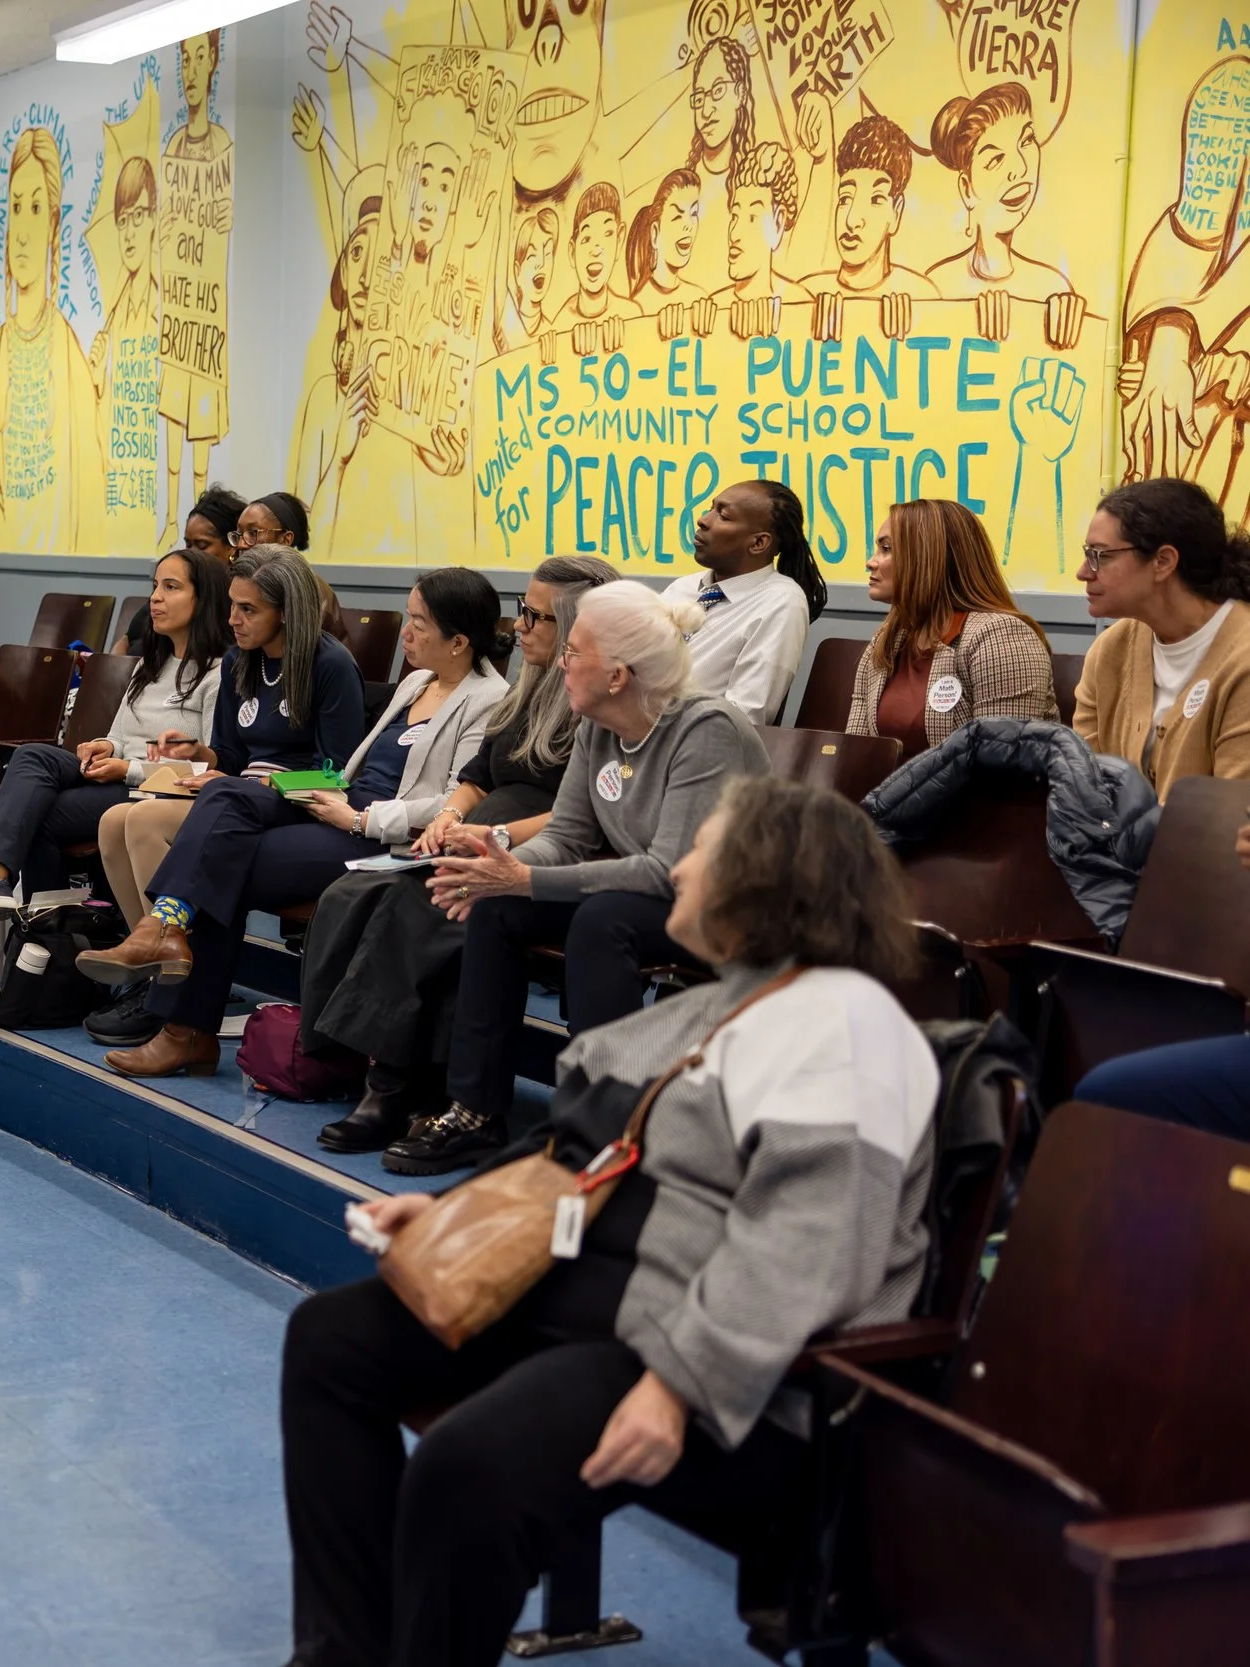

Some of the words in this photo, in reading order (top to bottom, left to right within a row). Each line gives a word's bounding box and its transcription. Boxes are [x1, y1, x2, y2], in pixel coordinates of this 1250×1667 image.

[789, 0, 856, 78] LOVE
[994, 0, 1069, 32] ADRE
[441, 48, 481, 69] MY
[805, 17, 857, 76] YOUR
[969, 6, 1058, 103] TIERRA
[104, 99, 129, 124] THE
[1195, 86, 1229, 110] SEE
[82, 150, 104, 223] WONG
[165, 161, 189, 193] CAN
[193, 167, 200, 200] A
[205, 151, 231, 199] MAN
[1184, 183, 1220, 201] NOT
[29, 102, 74, 189] CLIMATE
[57, 203, 78, 321] ACTIVIST
[168, 192, 195, 224] LOVE
[197, 198, 218, 230] GOD
[176, 228, 205, 267] and
[78, 234, 101, 317] JOSHUA
[162, 273, 192, 309] HATE
[196, 276, 220, 314] HIS
[431, 266, 481, 339] NOT
[160, 313, 226, 379] BROTHER?
[495, 363, 560, 422] MS
[748, 335, 1001, 412] PUENTE
[113, 403, 138, 428] INTO
[537, 403, 719, 446] COMMUNITY
[738, 399, 914, 444] SCHOOL
[495, 486, 530, 558] for
